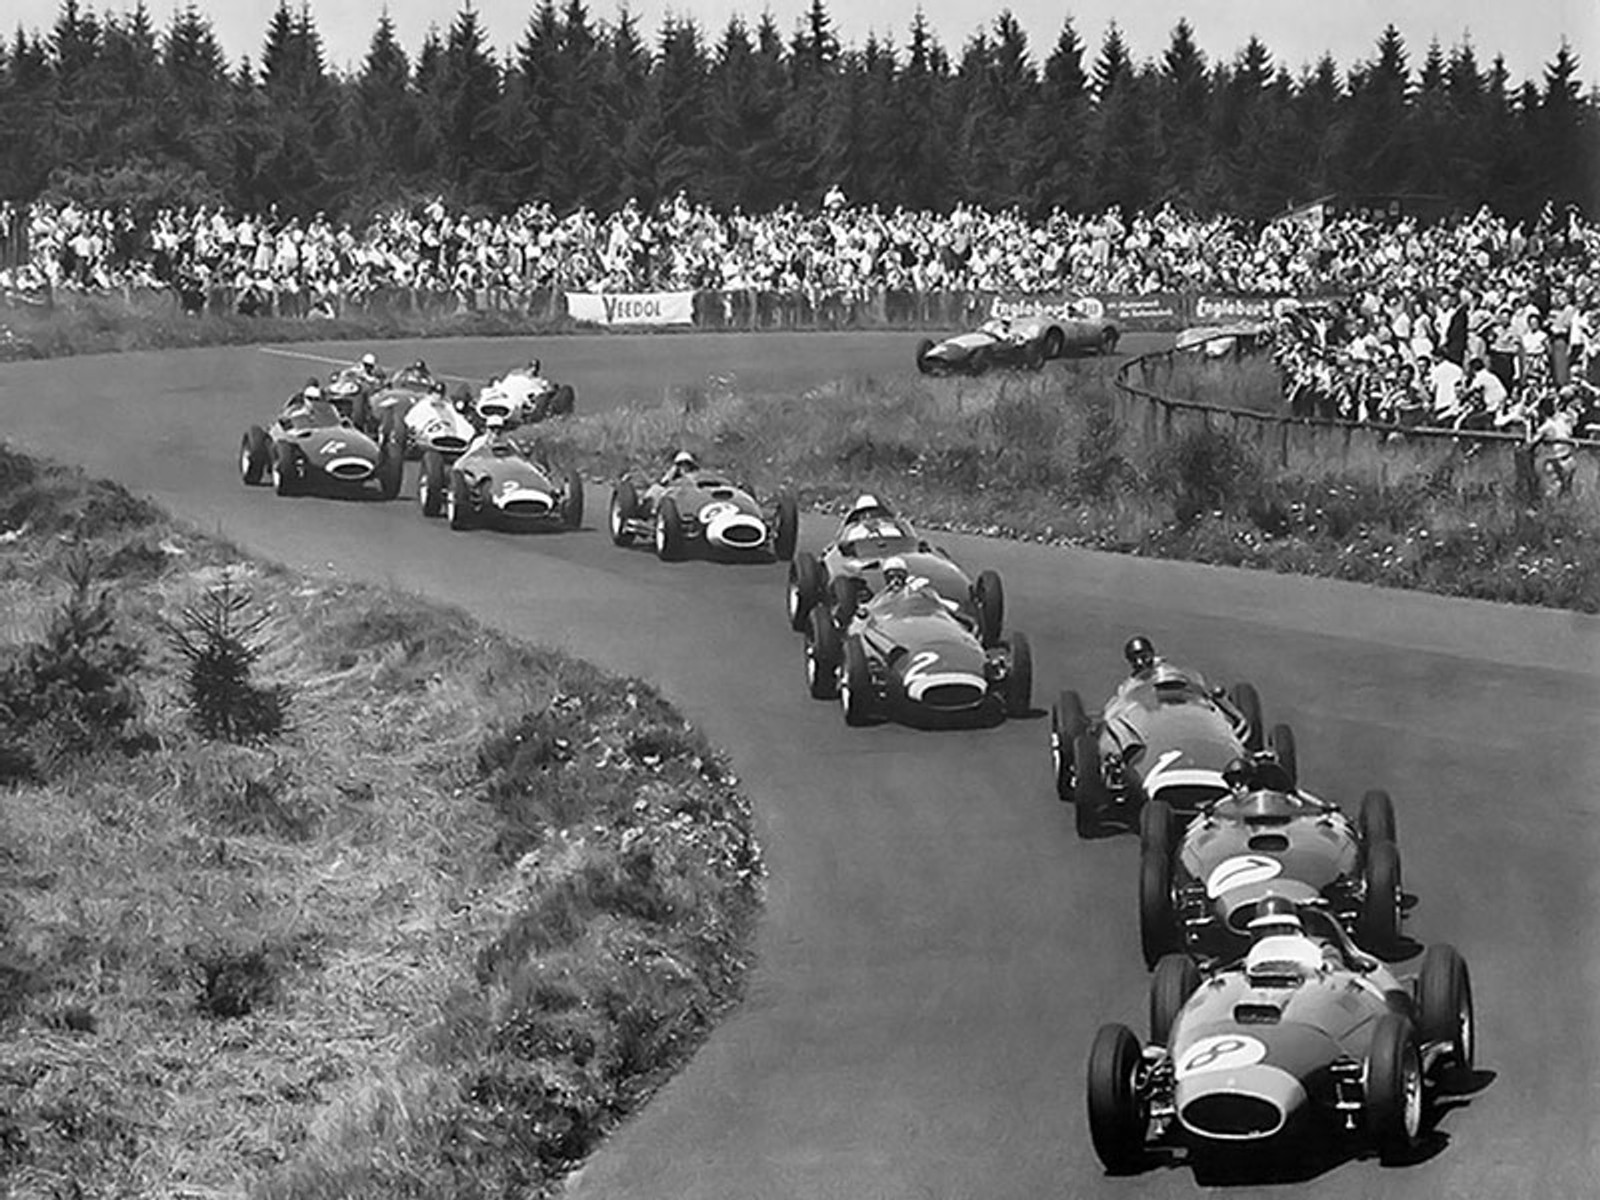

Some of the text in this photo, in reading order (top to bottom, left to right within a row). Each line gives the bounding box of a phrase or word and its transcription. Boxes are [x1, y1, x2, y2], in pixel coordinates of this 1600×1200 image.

[1196, 296, 1271, 318] Englebert
[903, 651, 940, 687] 2
[1143, 750, 1184, 790] 1
[1186, 1038, 1246, 1071] 8
